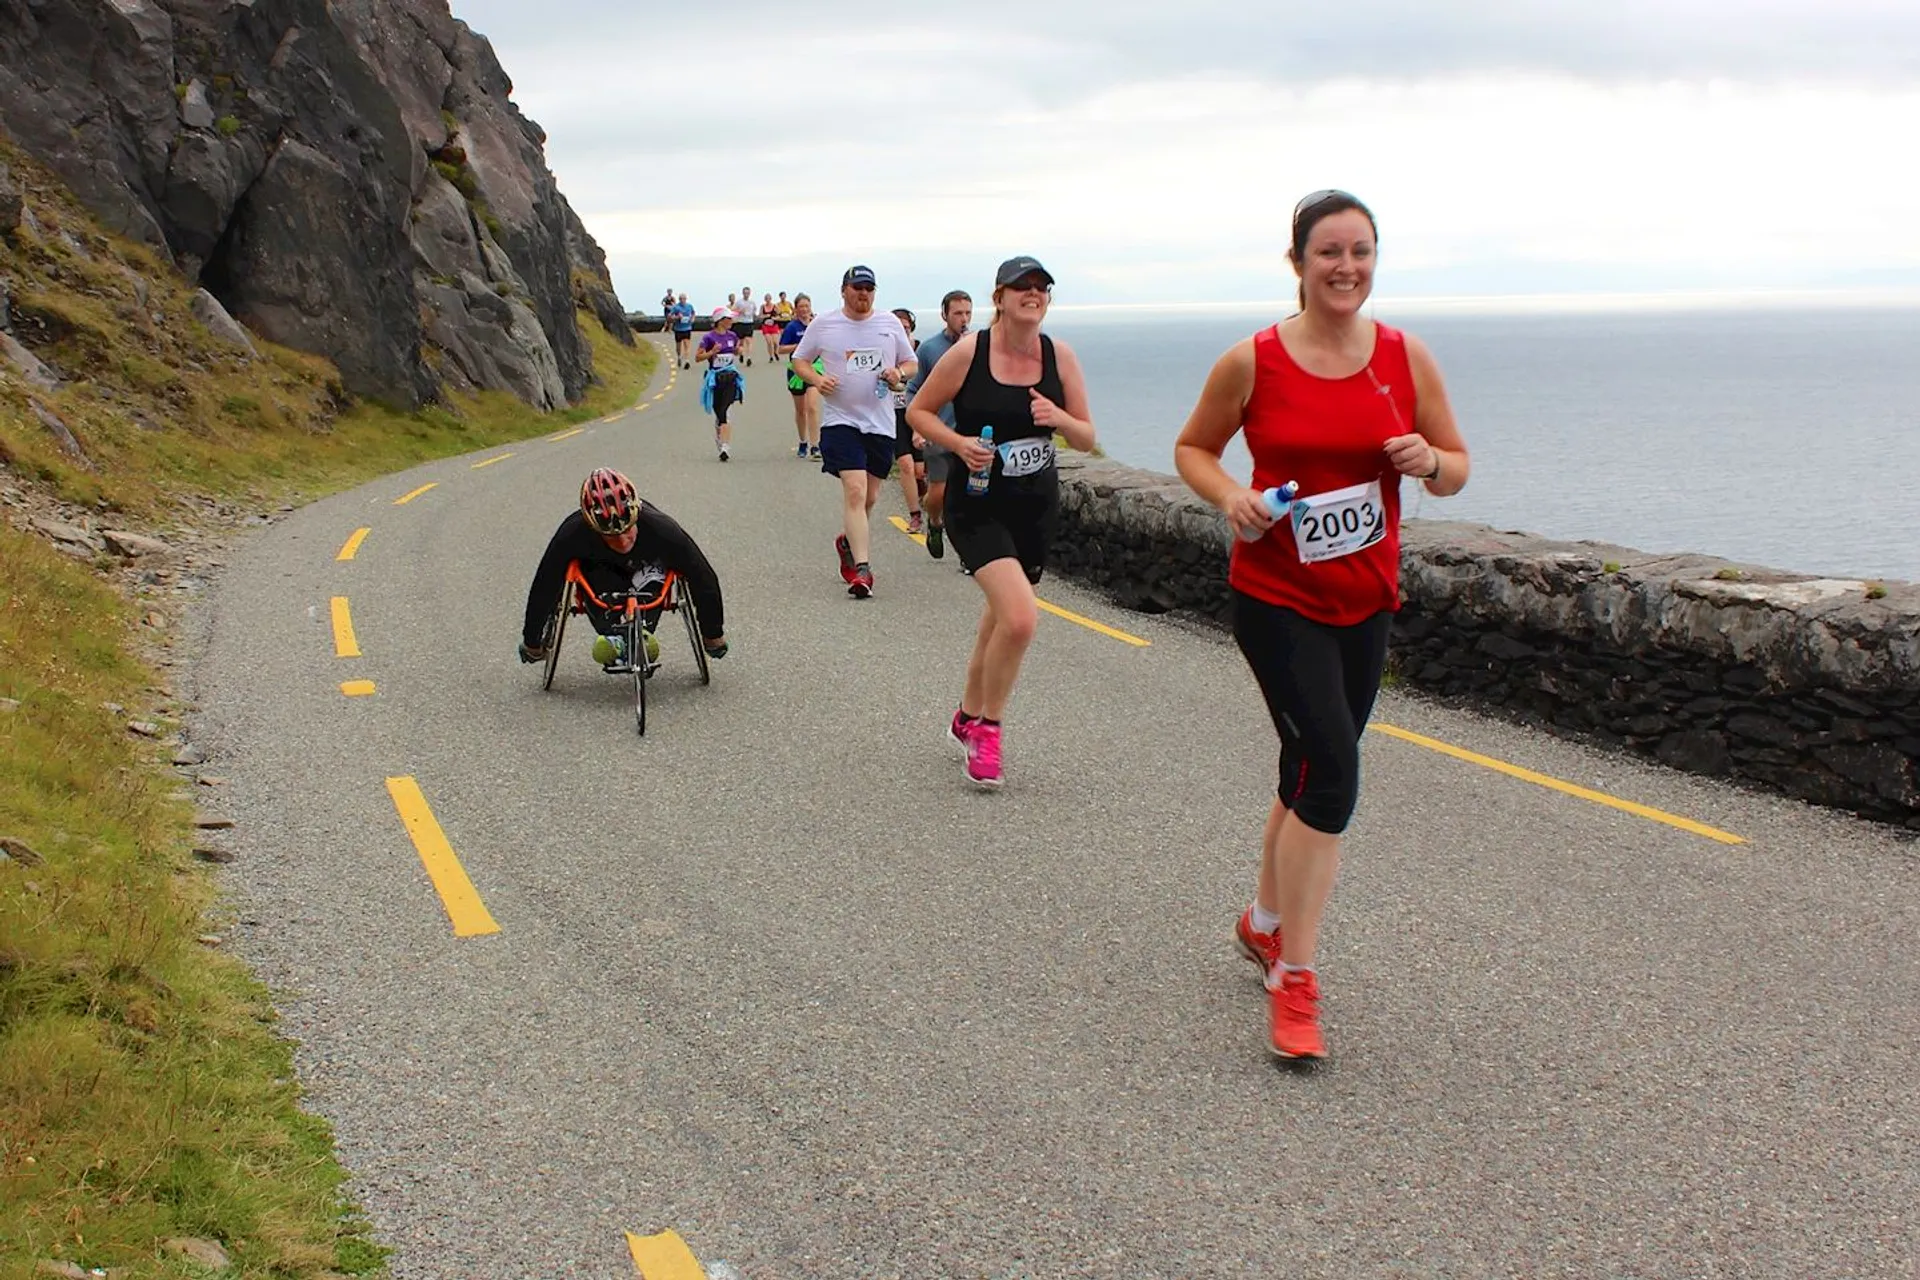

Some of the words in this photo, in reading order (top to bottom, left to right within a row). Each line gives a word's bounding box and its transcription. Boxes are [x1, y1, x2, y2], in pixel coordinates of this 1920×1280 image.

[854, 355, 874, 366] 181
[1010, 444, 1050, 468] 1995
[1303, 502, 1376, 542] 2003
